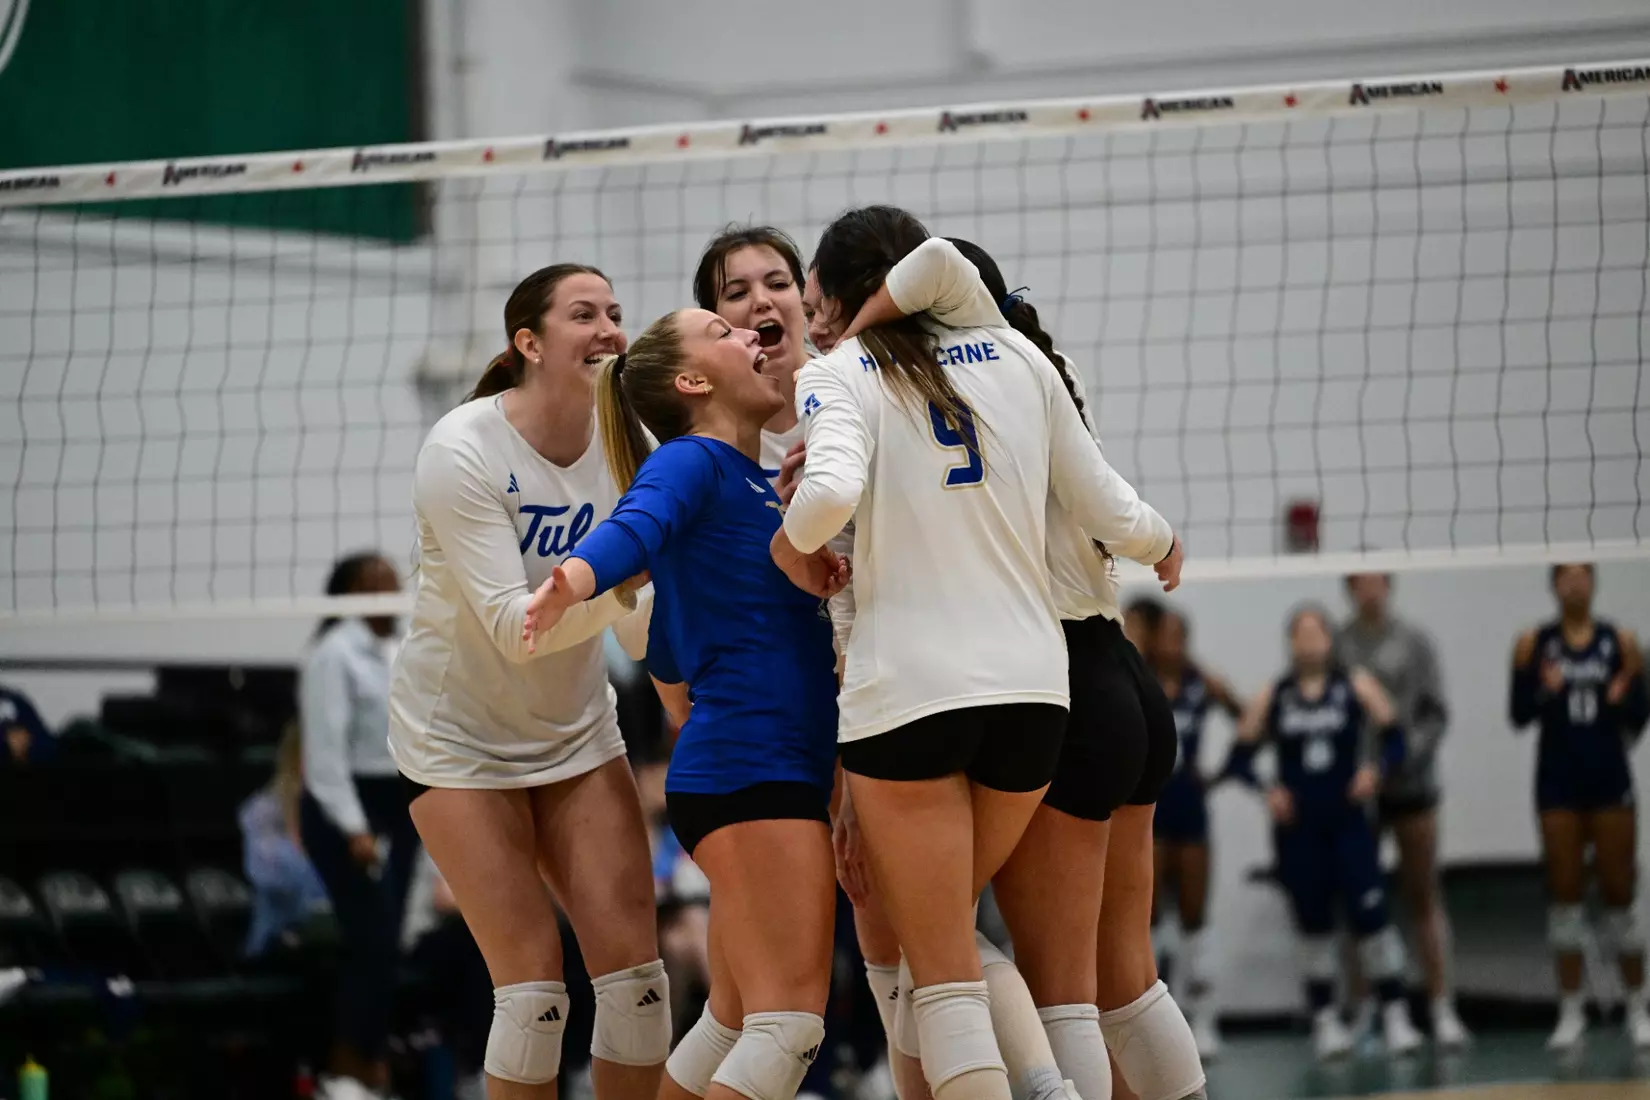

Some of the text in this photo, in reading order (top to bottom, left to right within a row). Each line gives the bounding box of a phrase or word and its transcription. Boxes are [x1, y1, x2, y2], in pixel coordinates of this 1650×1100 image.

[0, 177, 60, 190] MERICAN
[1350, 81, 1443, 105] AMERICAN
[859, 341, 1000, 372] HCANE
[923, 395, 988, 491] 9
[519, 502, 595, 557] Tul
